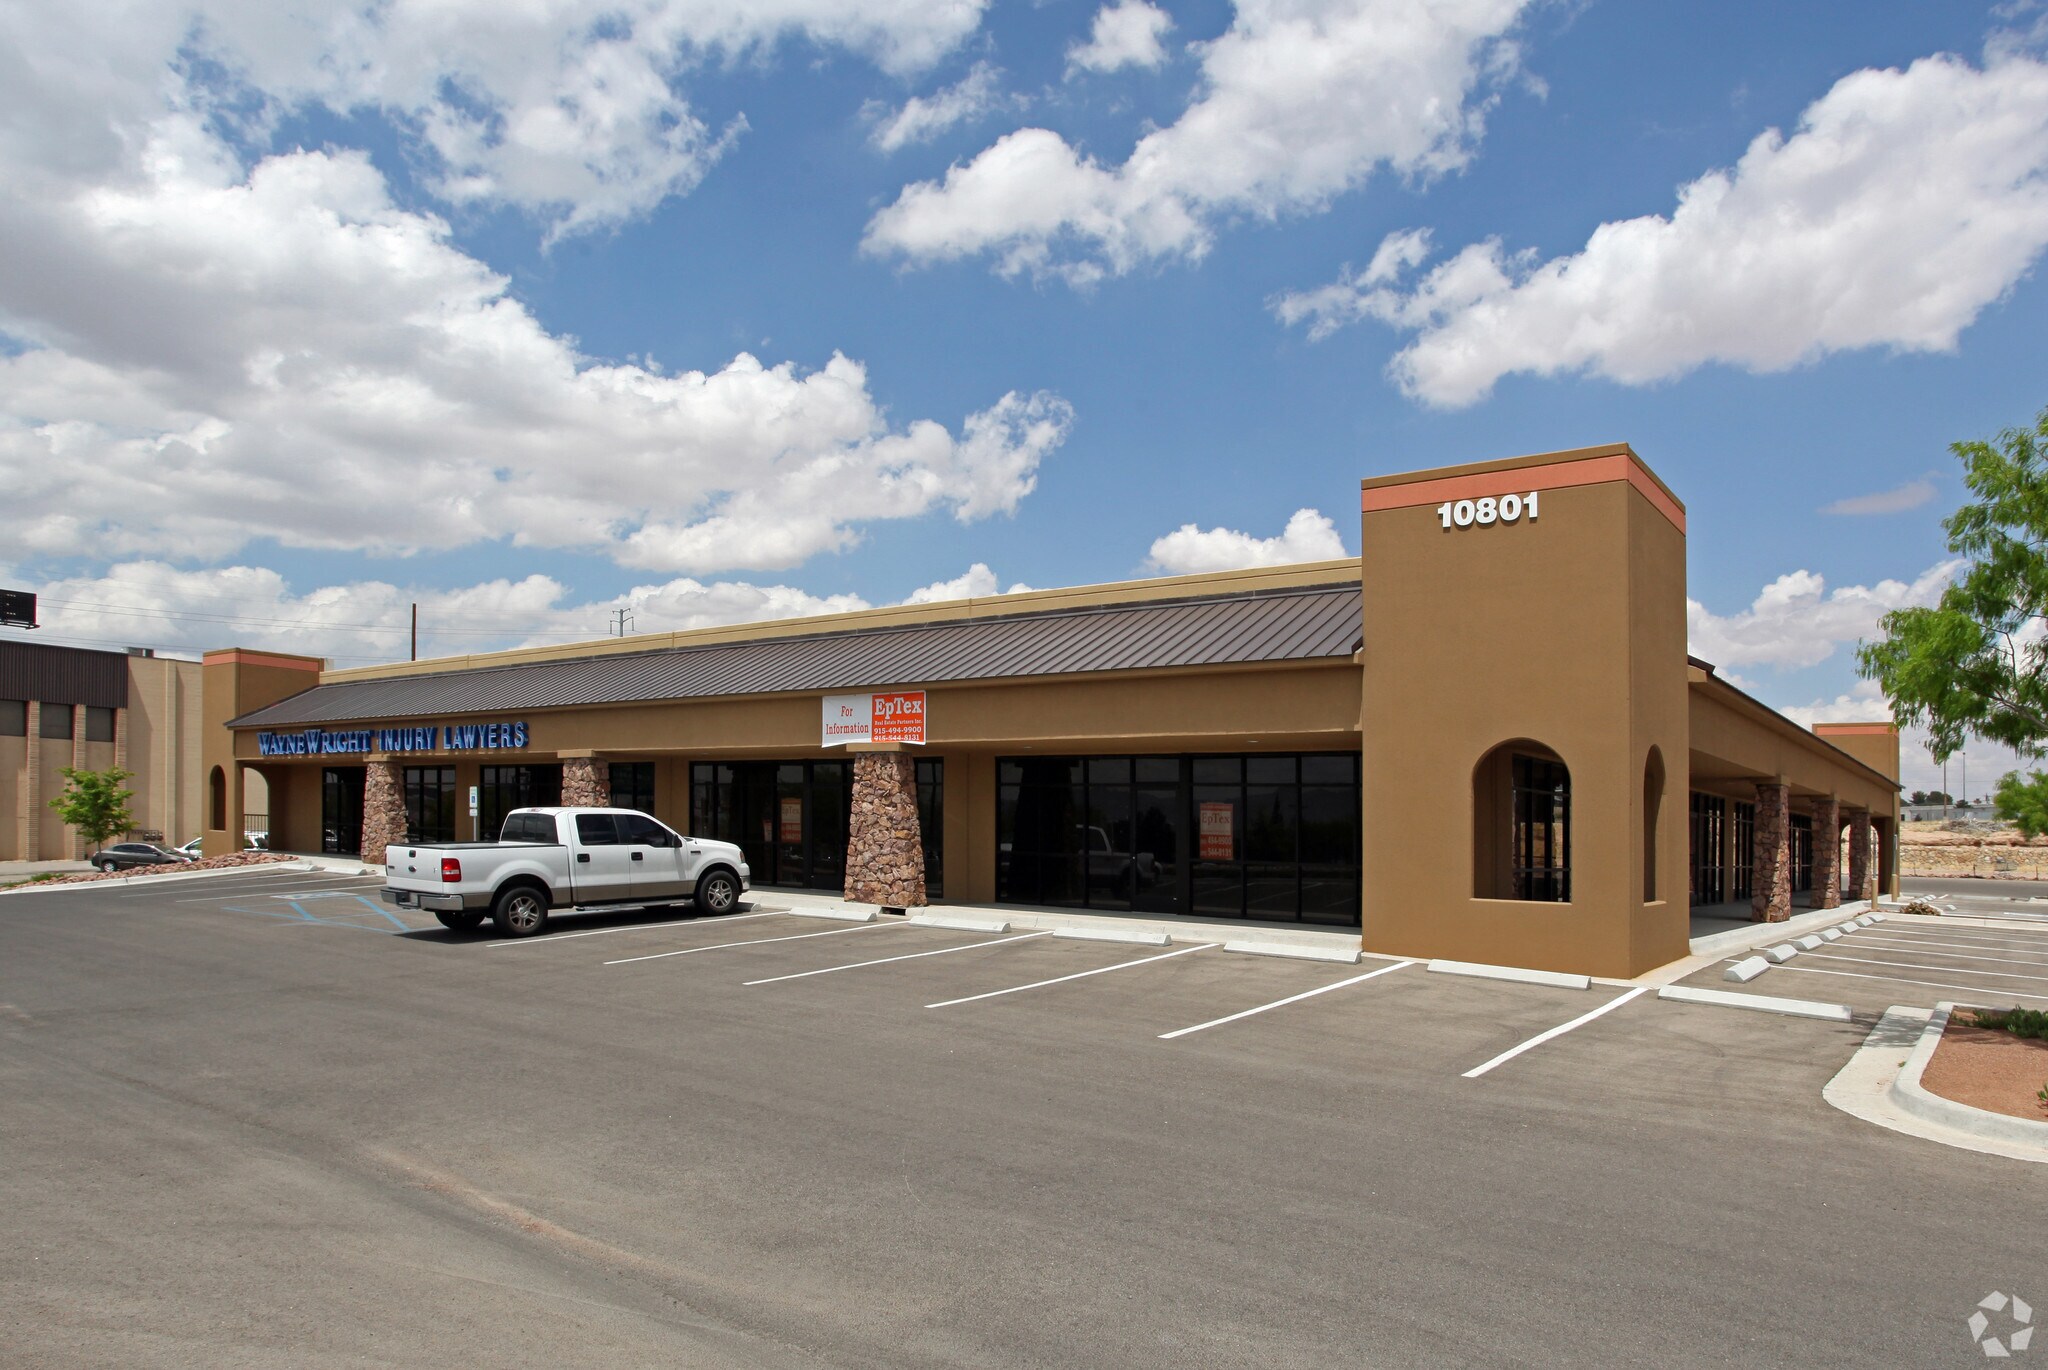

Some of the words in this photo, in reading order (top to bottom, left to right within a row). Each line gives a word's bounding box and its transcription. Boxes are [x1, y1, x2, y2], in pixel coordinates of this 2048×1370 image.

[1437, 491, 1538, 528] 10801
[840, 705, 854, 717] For
[874, 697, 922, 719] EpTex
[825, 722, 869, 735] Information
[874, 726, 922, 735] 915-494-9900
[378, 727, 436, 751] INJURY
[443, 721, 528, 750] LAWYERS
[873, 734, 920, 742] 915-544-8131
[1201, 812, 1231, 825] EpTex
